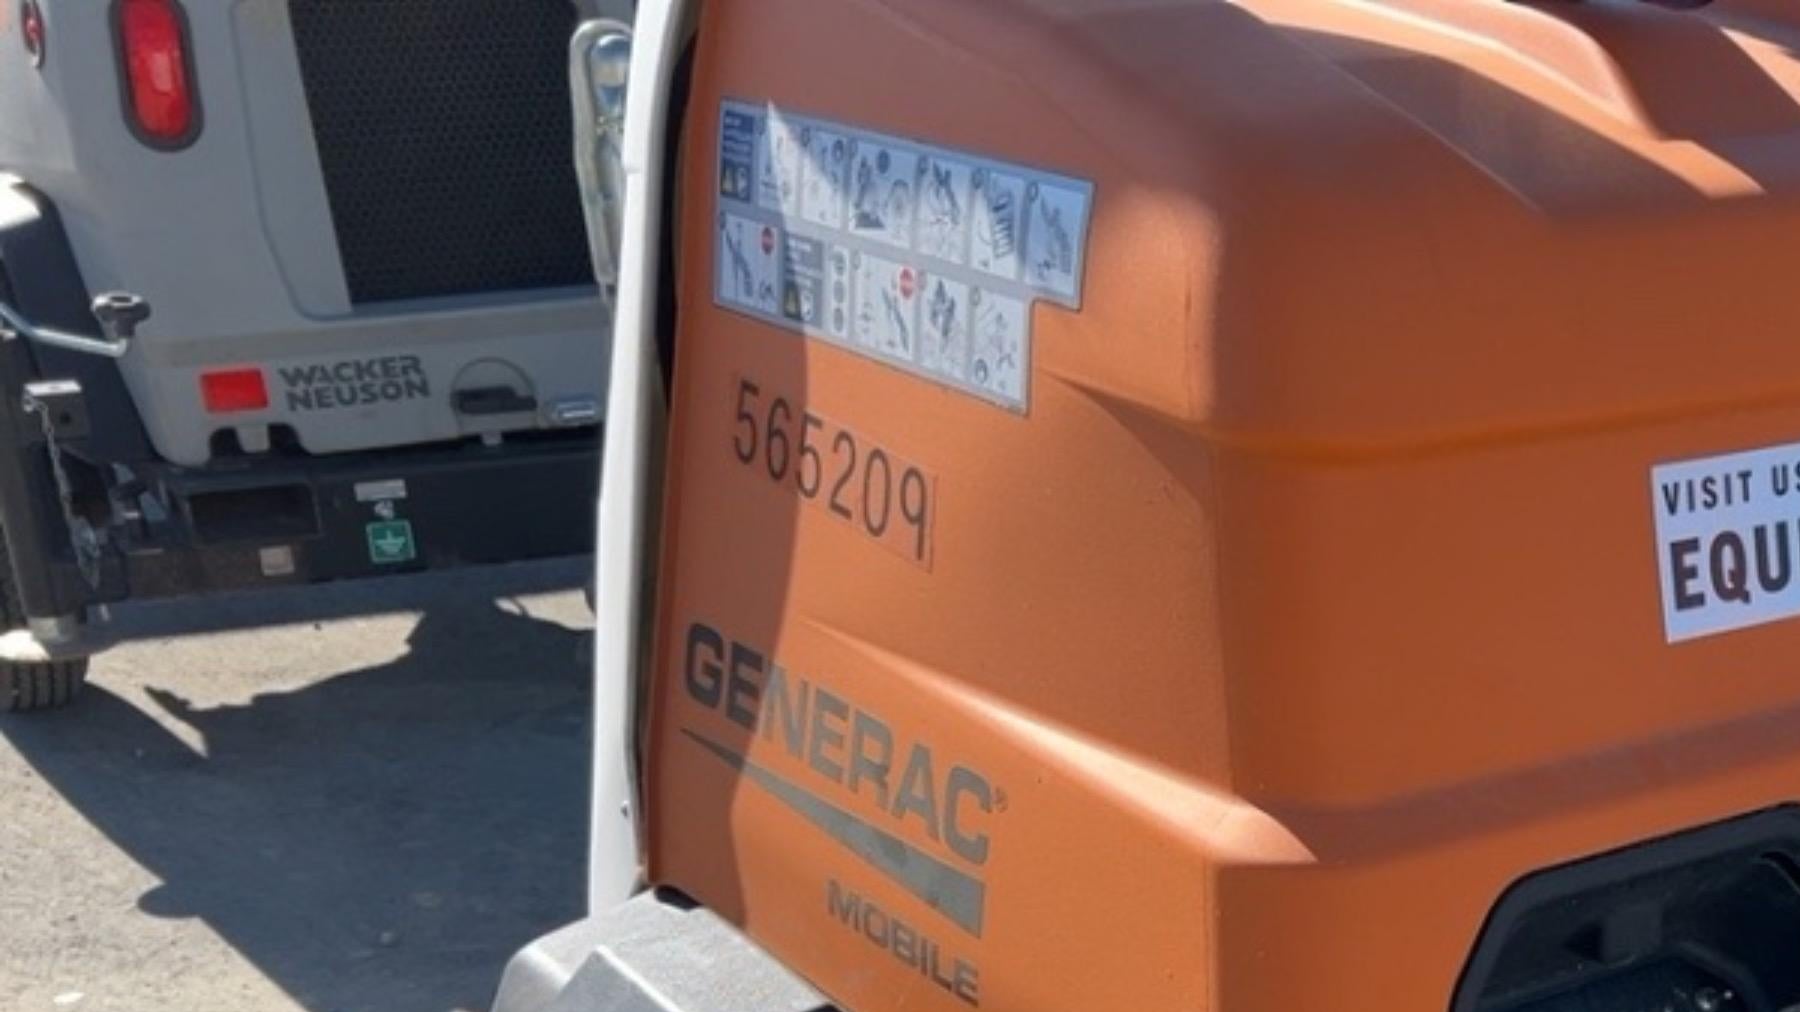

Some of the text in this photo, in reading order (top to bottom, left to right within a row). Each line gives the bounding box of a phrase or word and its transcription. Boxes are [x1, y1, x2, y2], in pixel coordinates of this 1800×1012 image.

[278, 354, 422, 388] WACKER
[284, 379, 431, 412] NEUSON
[734, 378, 928, 562] 565209
[1662, 469, 1753, 517] VISIT
[685, 621, 992, 866] GENERAC
[825, 877, 981, 1008] MOBILE
